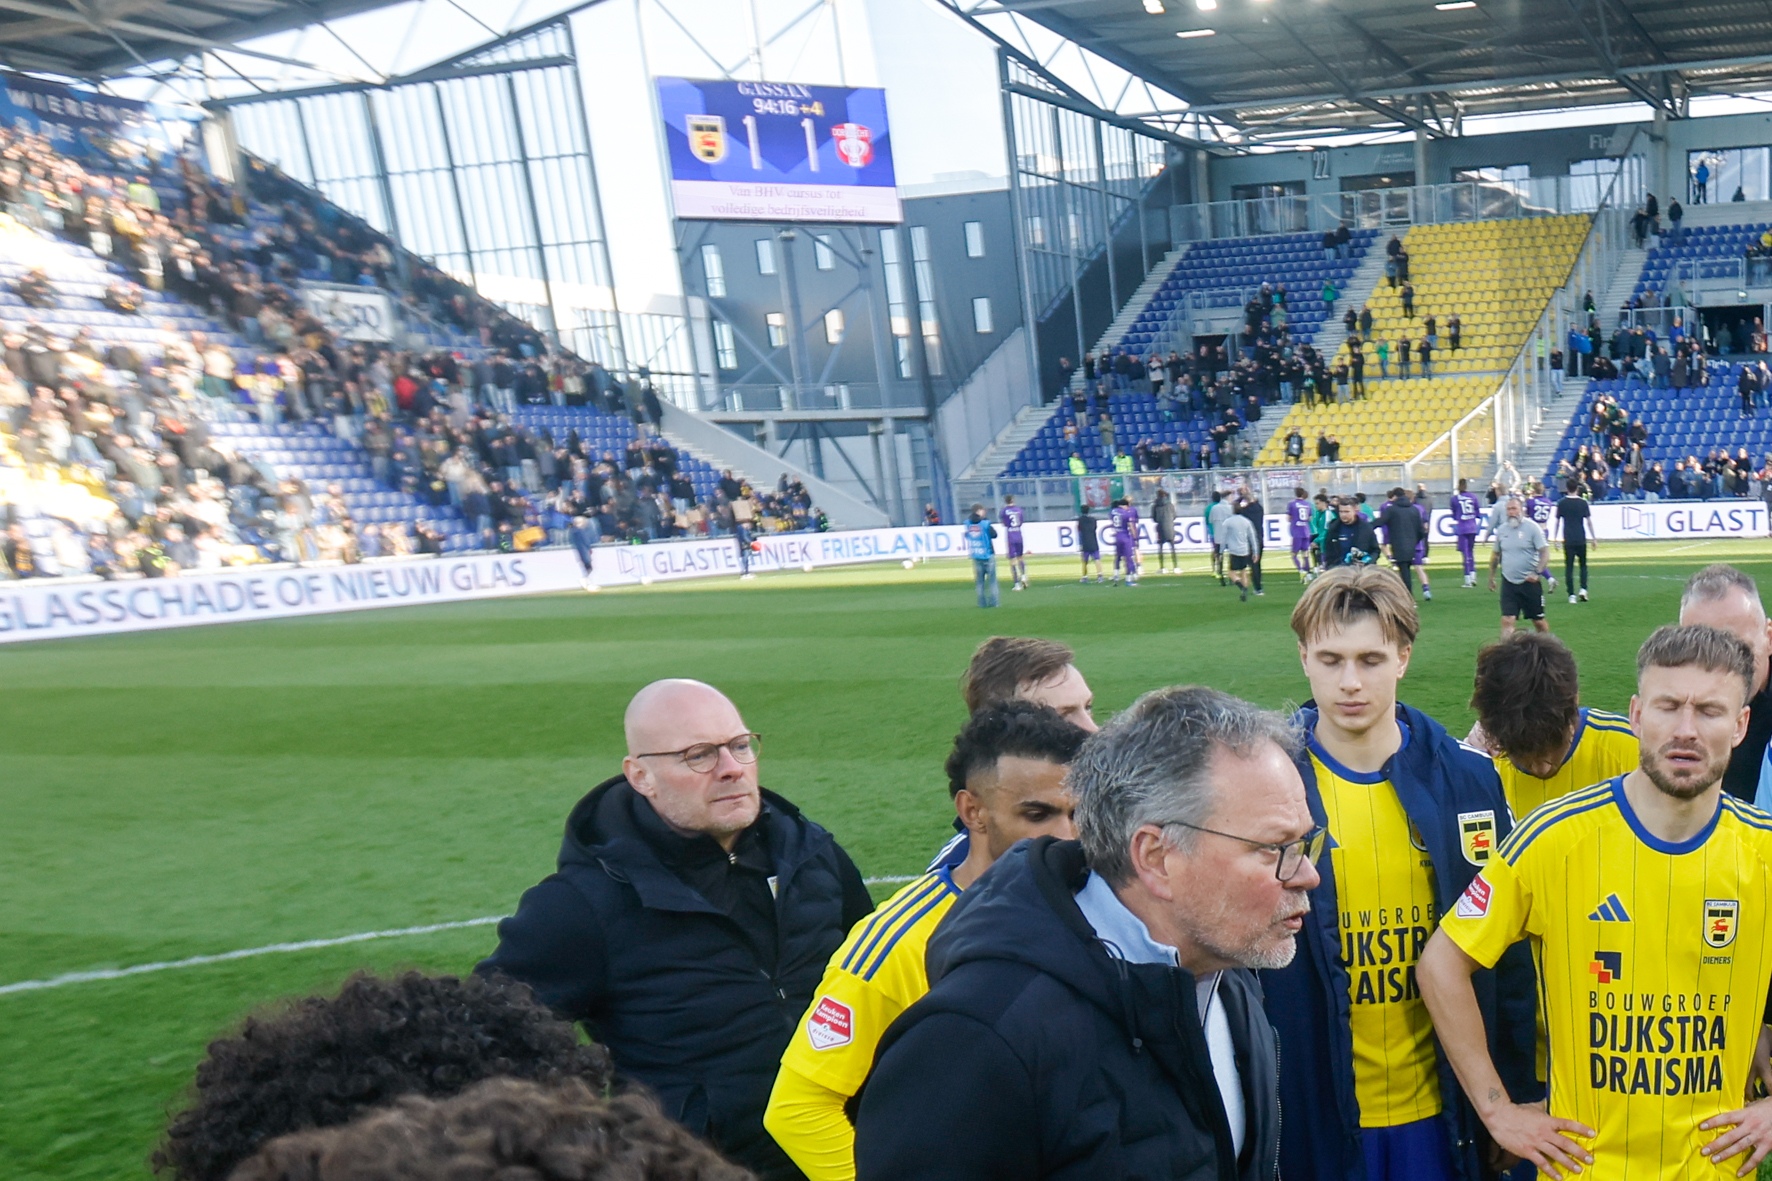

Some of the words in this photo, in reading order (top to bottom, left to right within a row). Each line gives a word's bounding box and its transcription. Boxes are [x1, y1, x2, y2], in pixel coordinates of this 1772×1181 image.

[753, 98, 799, 115] 94:16
[799, 101, 825, 116] +4
[1313, 151, 1329, 179] 22
[729, 185, 751, 197] Van
[754, 186, 784, 198] BHV
[787, 188, 822, 199] cursus
[826, 188, 841, 199] tot
[711, 204, 765, 217] volledige
[767, 204, 866, 218] bedrijfsveiligheid
[652, 540, 814, 575] GLASTEHNIEK
[276, 572, 322, 606] OF
[331, 565, 441, 601] NIEUW
[451, 558, 527, 591] GLAS
[1342, 903, 1433, 929] UWGROE
[1341, 925, 1432, 967] JKSTR
[1703, 956, 1731, 965] DIEMERS
[1347, 965, 1421, 1005] AISM
[820, 1003, 846, 1021] Keuken
[1589, 990, 1731, 1012] BOUWGROEP
[1589, 1012, 1726, 1054] DIJKSTRA
[1590, 1052, 1723, 1096] DRAISMA
